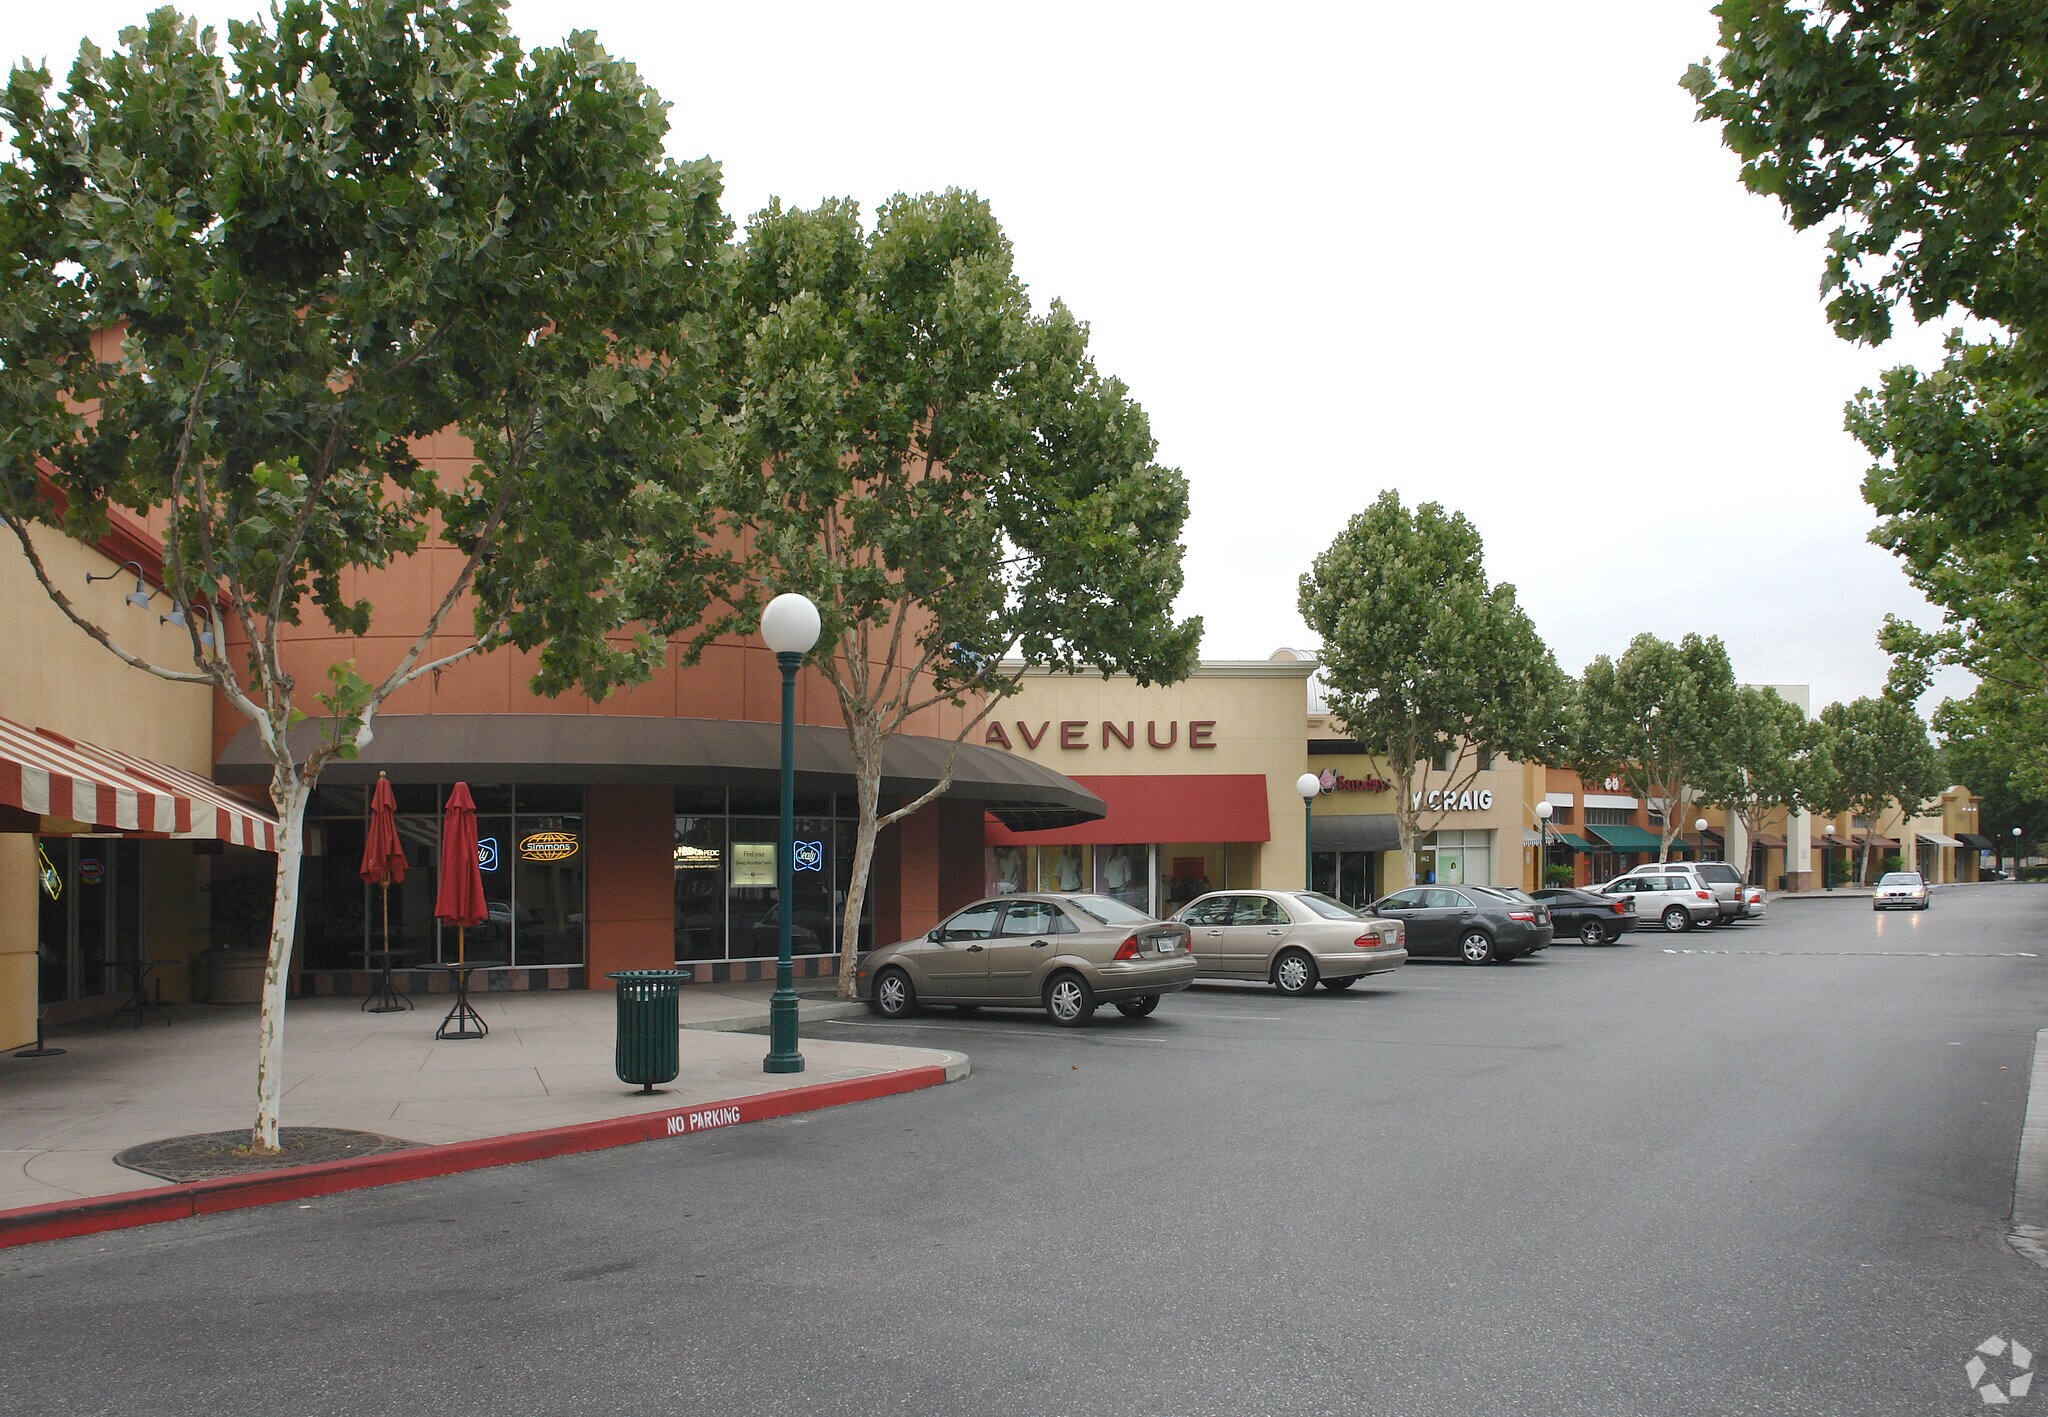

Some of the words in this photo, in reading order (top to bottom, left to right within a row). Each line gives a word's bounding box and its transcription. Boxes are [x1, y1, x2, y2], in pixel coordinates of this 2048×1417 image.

[985, 720, 1217, 749] AVENUE
[1428, 789, 1492, 811] CRAIG
[527, 842, 570, 850] Simmons
[754, 851, 765, 859] your
[797, 848, 817, 863] Sealy
[666, 1115, 685, 1135] NO
[689, 1106, 740, 1130] PARKING
